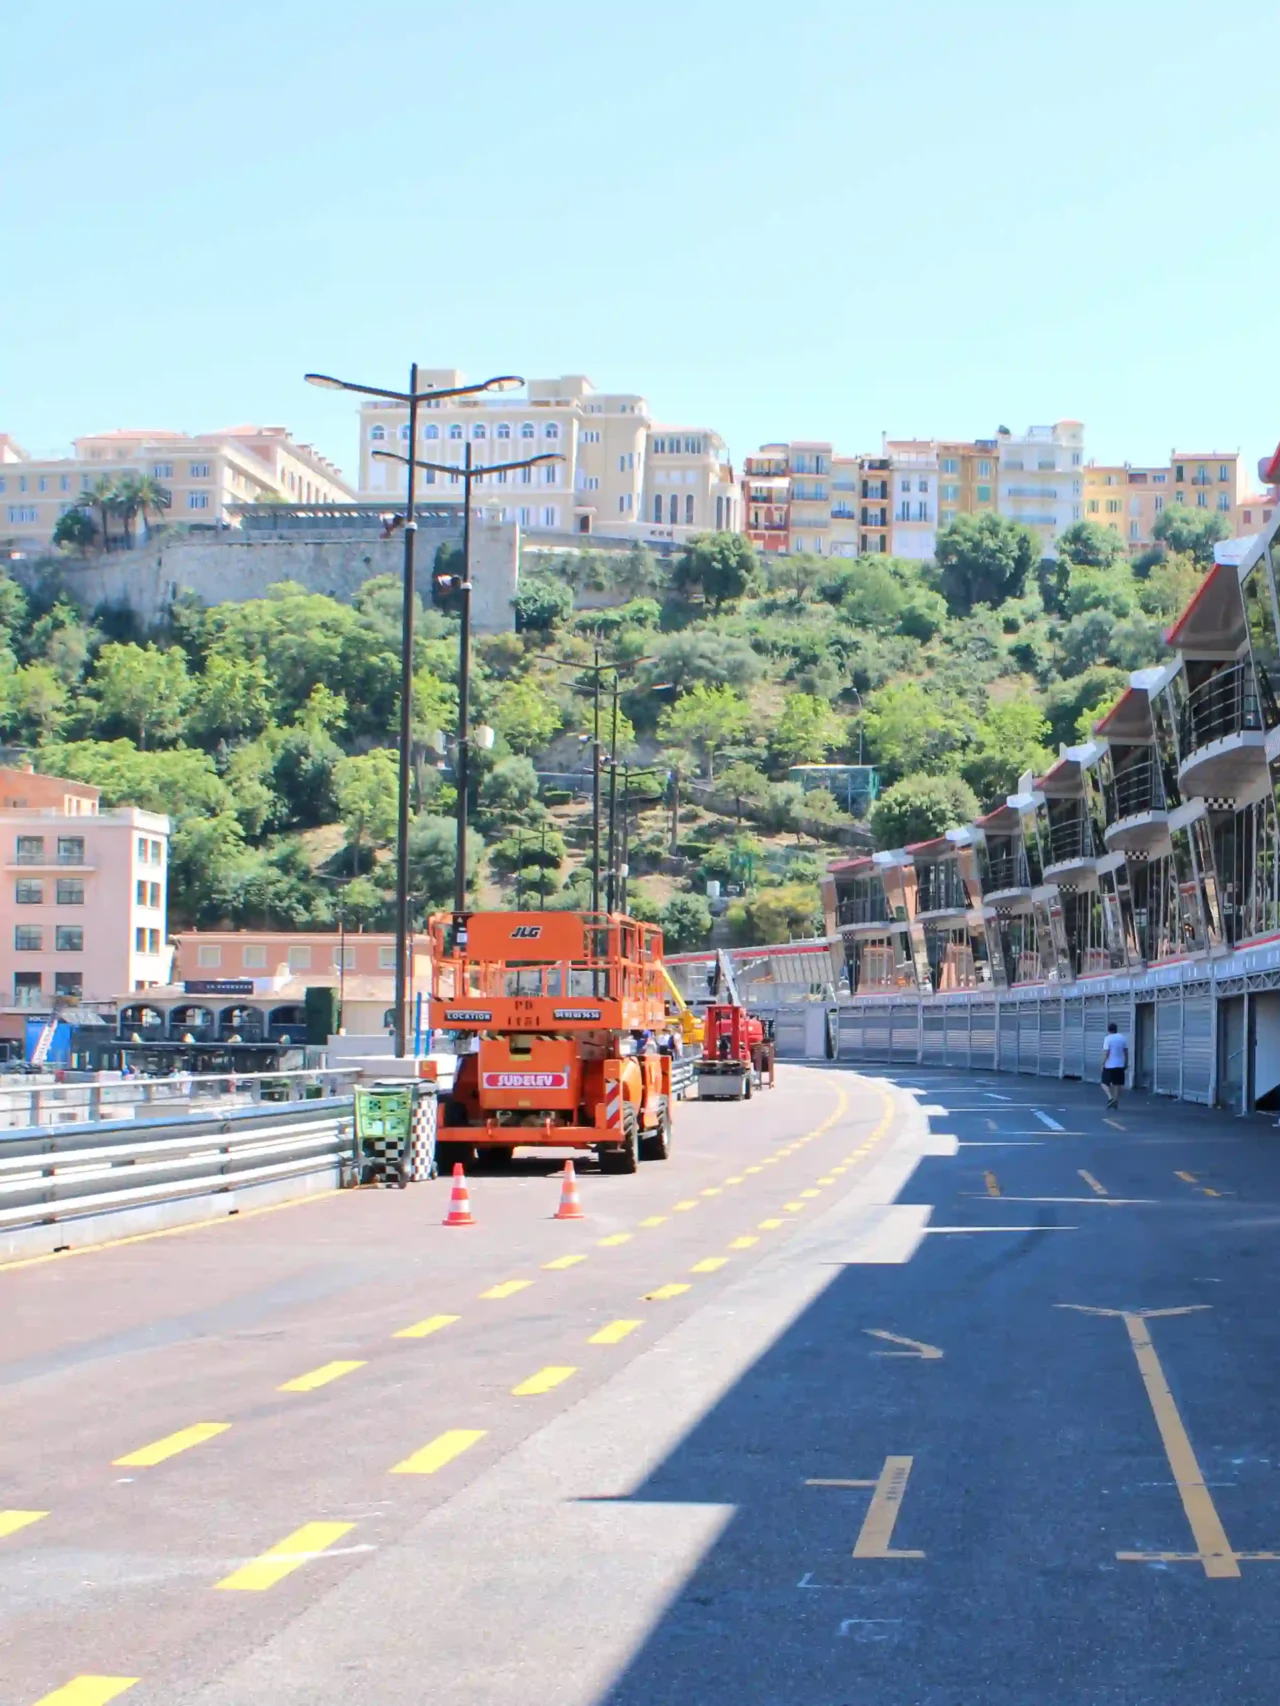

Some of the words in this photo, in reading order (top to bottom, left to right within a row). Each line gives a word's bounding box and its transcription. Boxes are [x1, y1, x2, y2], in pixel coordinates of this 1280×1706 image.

[510, 926, 542, 938] JLG
[447, 1012, 491, 1020] LOCATION
[497, 1074, 553, 1086] SUDELEV
